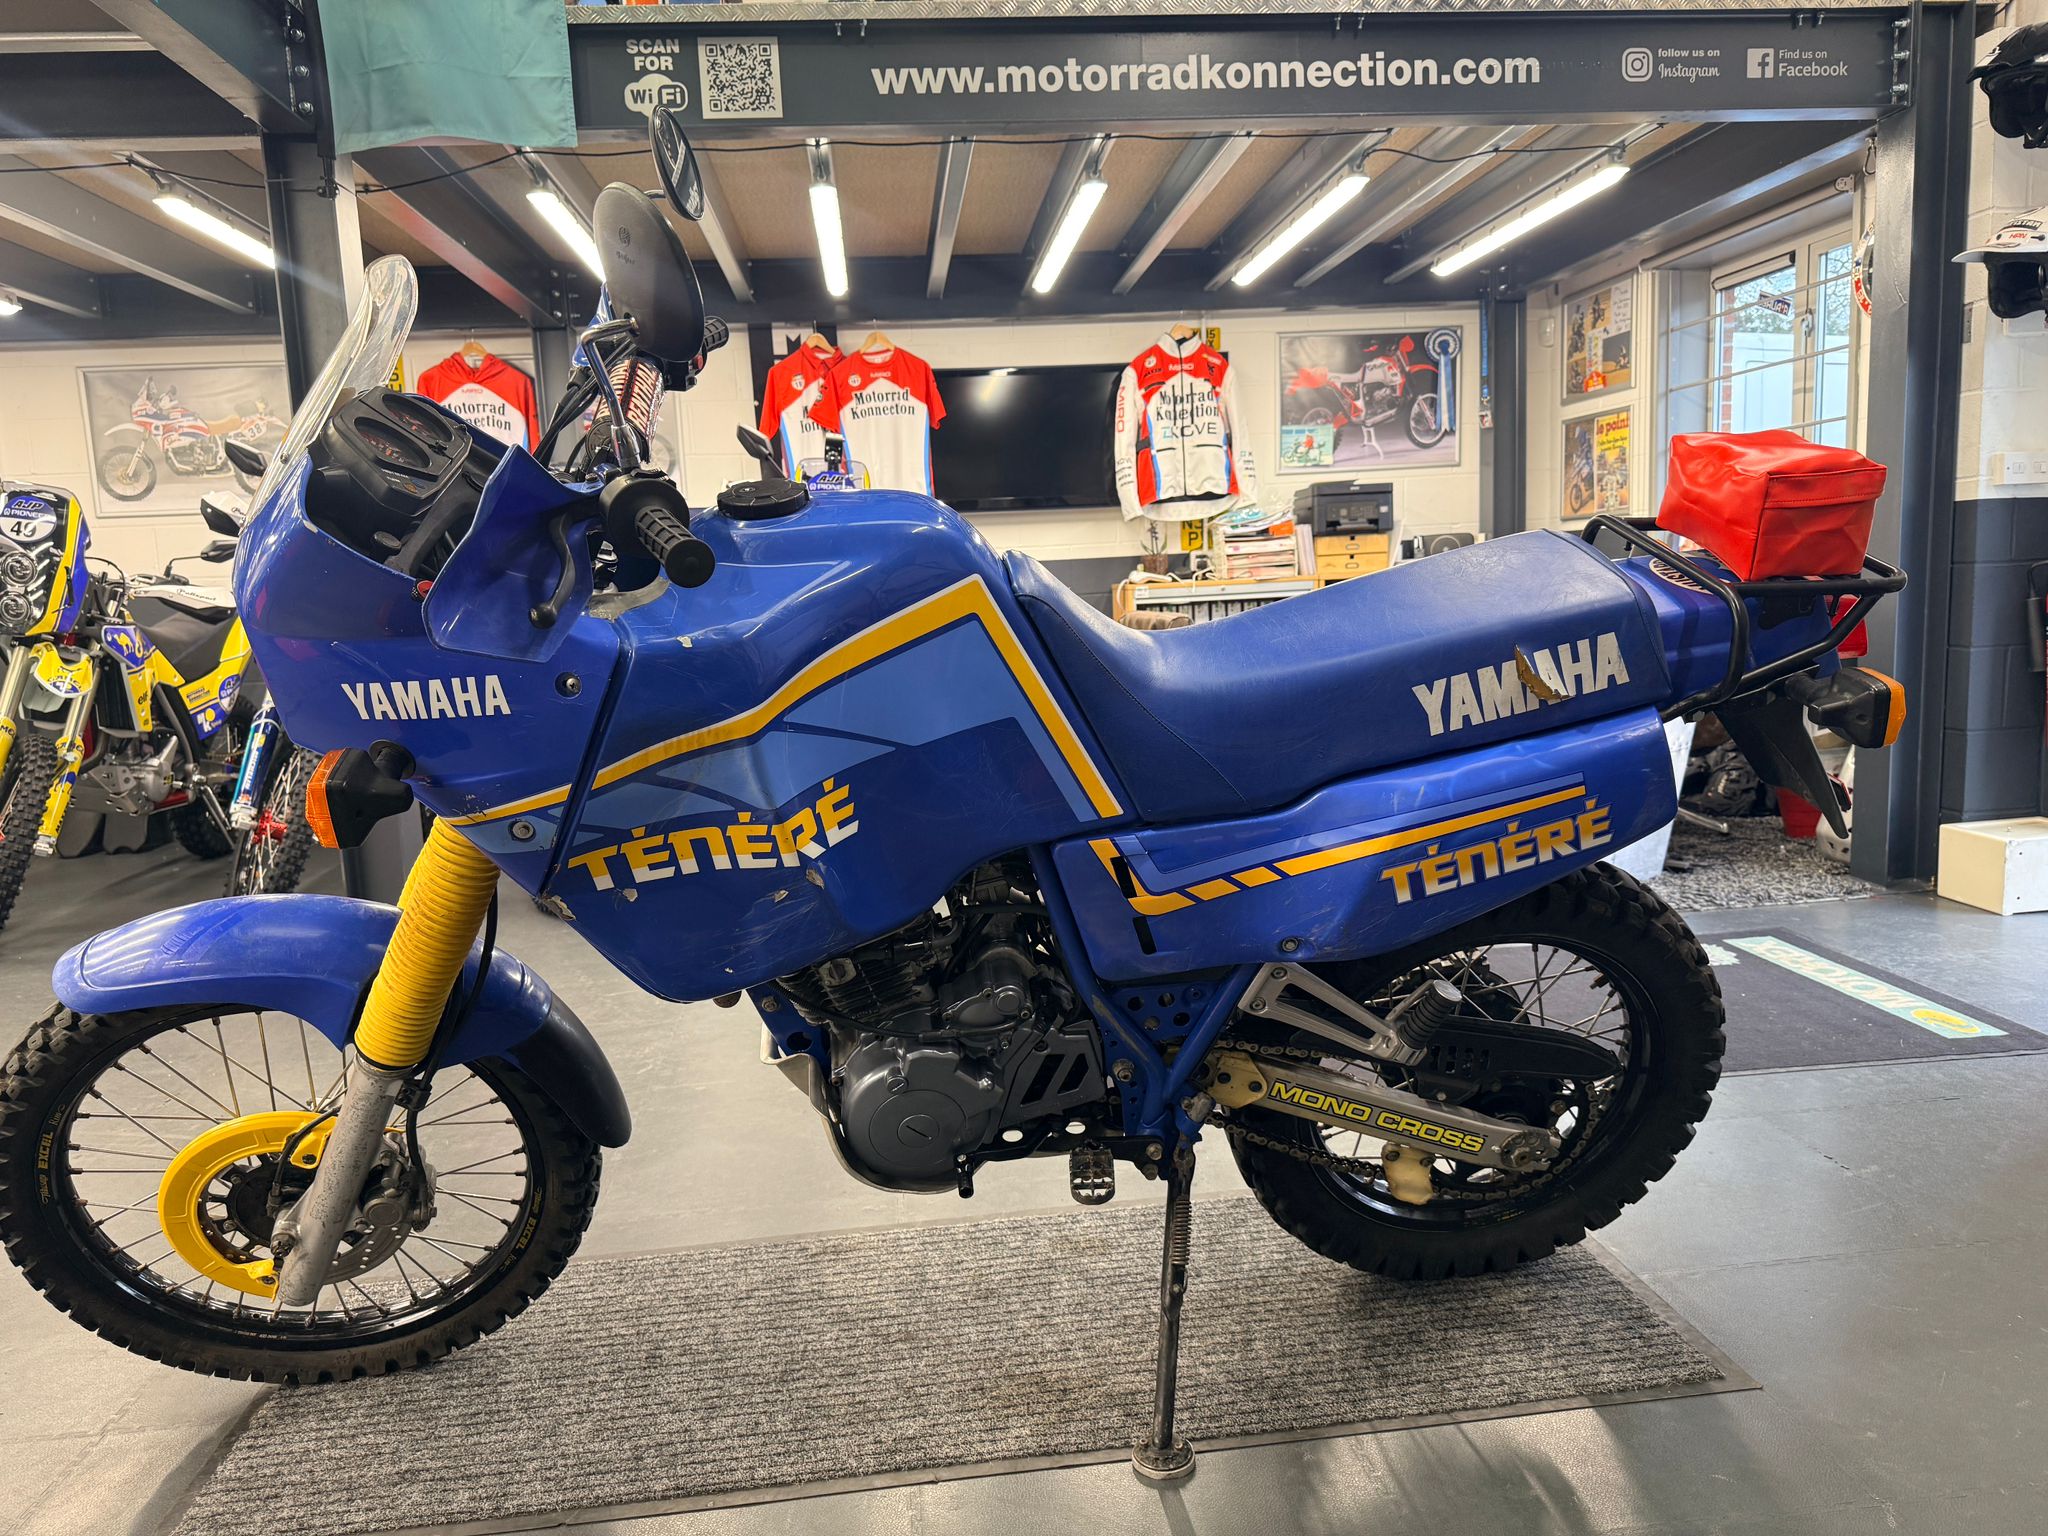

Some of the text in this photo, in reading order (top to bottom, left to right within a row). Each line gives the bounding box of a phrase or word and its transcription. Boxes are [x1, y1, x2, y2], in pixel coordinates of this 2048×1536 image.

[625, 39, 680, 54] SCAN
[1658, 48, 1721, 57] follow us on
[1779, 49, 1828, 59] Find us on
[634, 56, 674, 71] FOR
[870, 51, 1541, 95] www.motorradkonnection.com
[1658, 62, 1721, 84] Instagram
[1778, 60, 1849, 77] Facebook
[626, 361, 660, 439] RENTHAL
[1117, 385, 1126, 433] MIRO
[247, 422, 263, 438] 38
[11, 499, 45, 510] AJP
[1411, 631, 1631, 737] YAMAHA
[340, 674, 512, 721] YAMAHA
[1270, 1081, 1486, 1154] MONO CROSS
